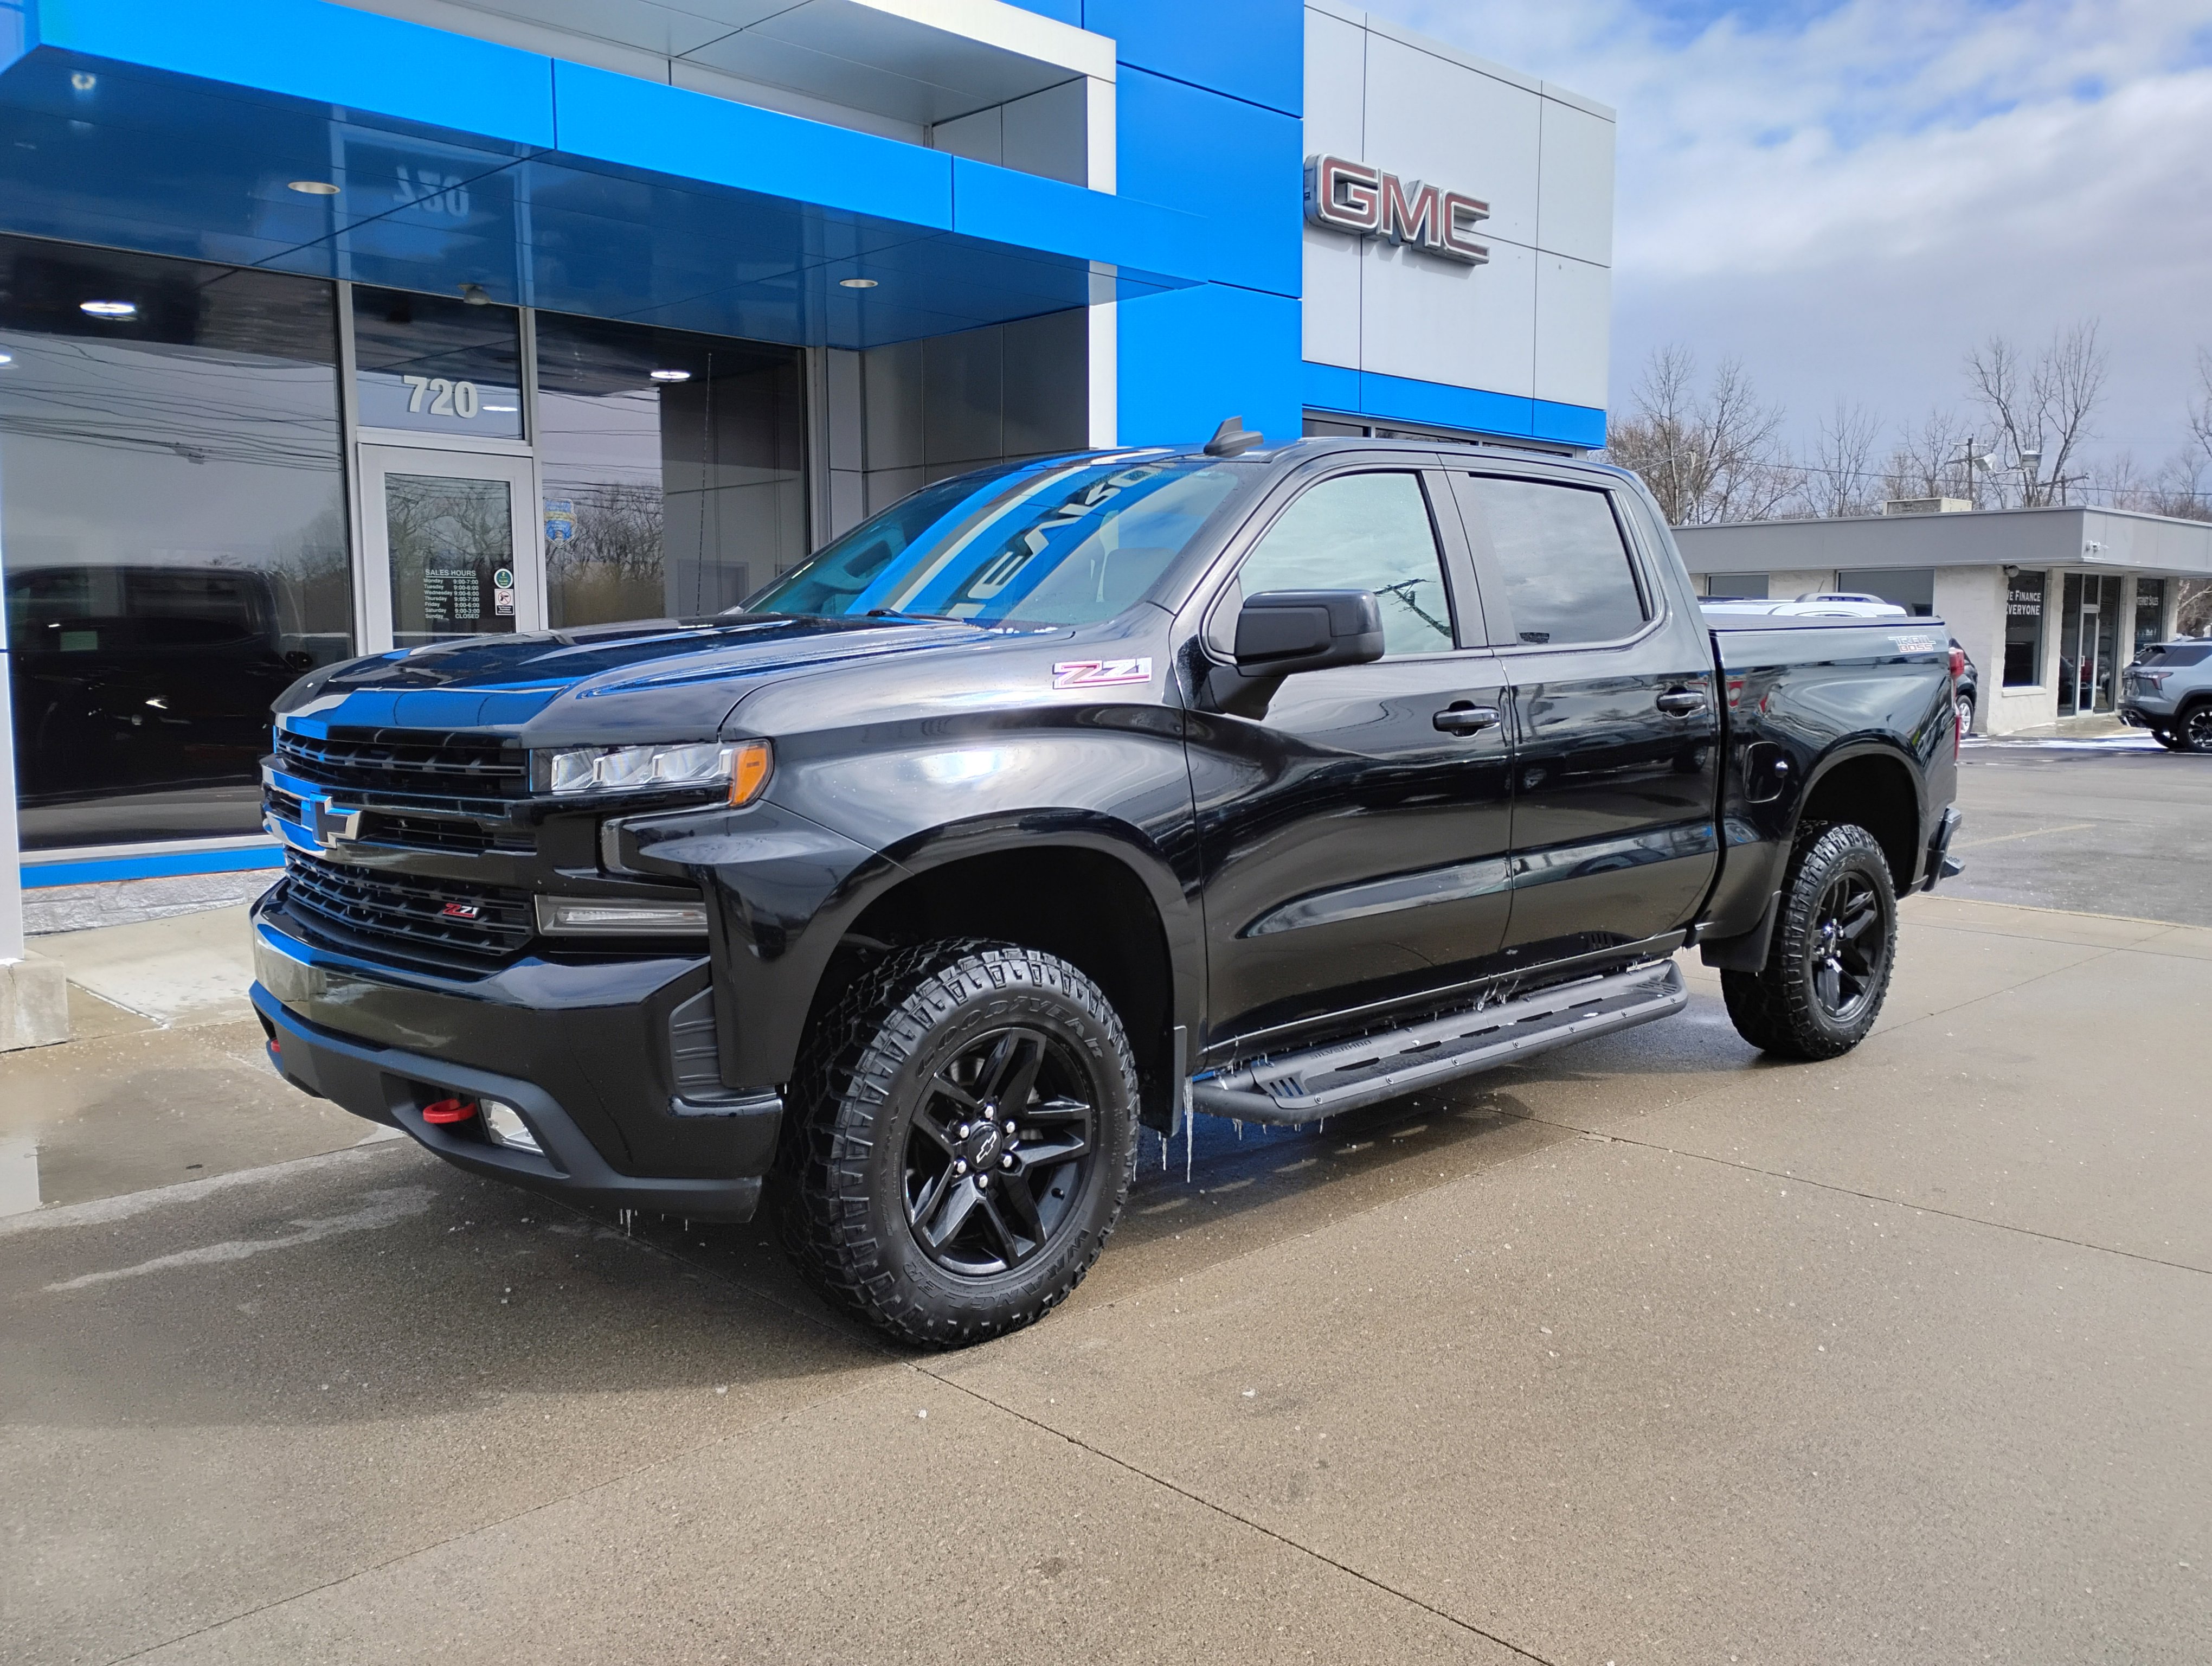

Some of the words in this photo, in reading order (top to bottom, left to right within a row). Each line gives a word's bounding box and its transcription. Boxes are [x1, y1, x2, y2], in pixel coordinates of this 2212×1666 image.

[1311, 153, 1490, 265] GMC
[403, 375, 478, 418] 720
[2015, 589, 2041, 601] FINANCE
[1888, 635, 1937, 646] TRAIL
[1898, 644, 1934, 653] BOSS
[1052, 657, 1158, 690] Z71
[442, 903, 479, 918] Z71
[916, 996, 1103, 1078] GOODYEAR
[1310, 1039, 1372, 1060] SILVERADO
[903, 1228, 1091, 1311] WRANGLER
